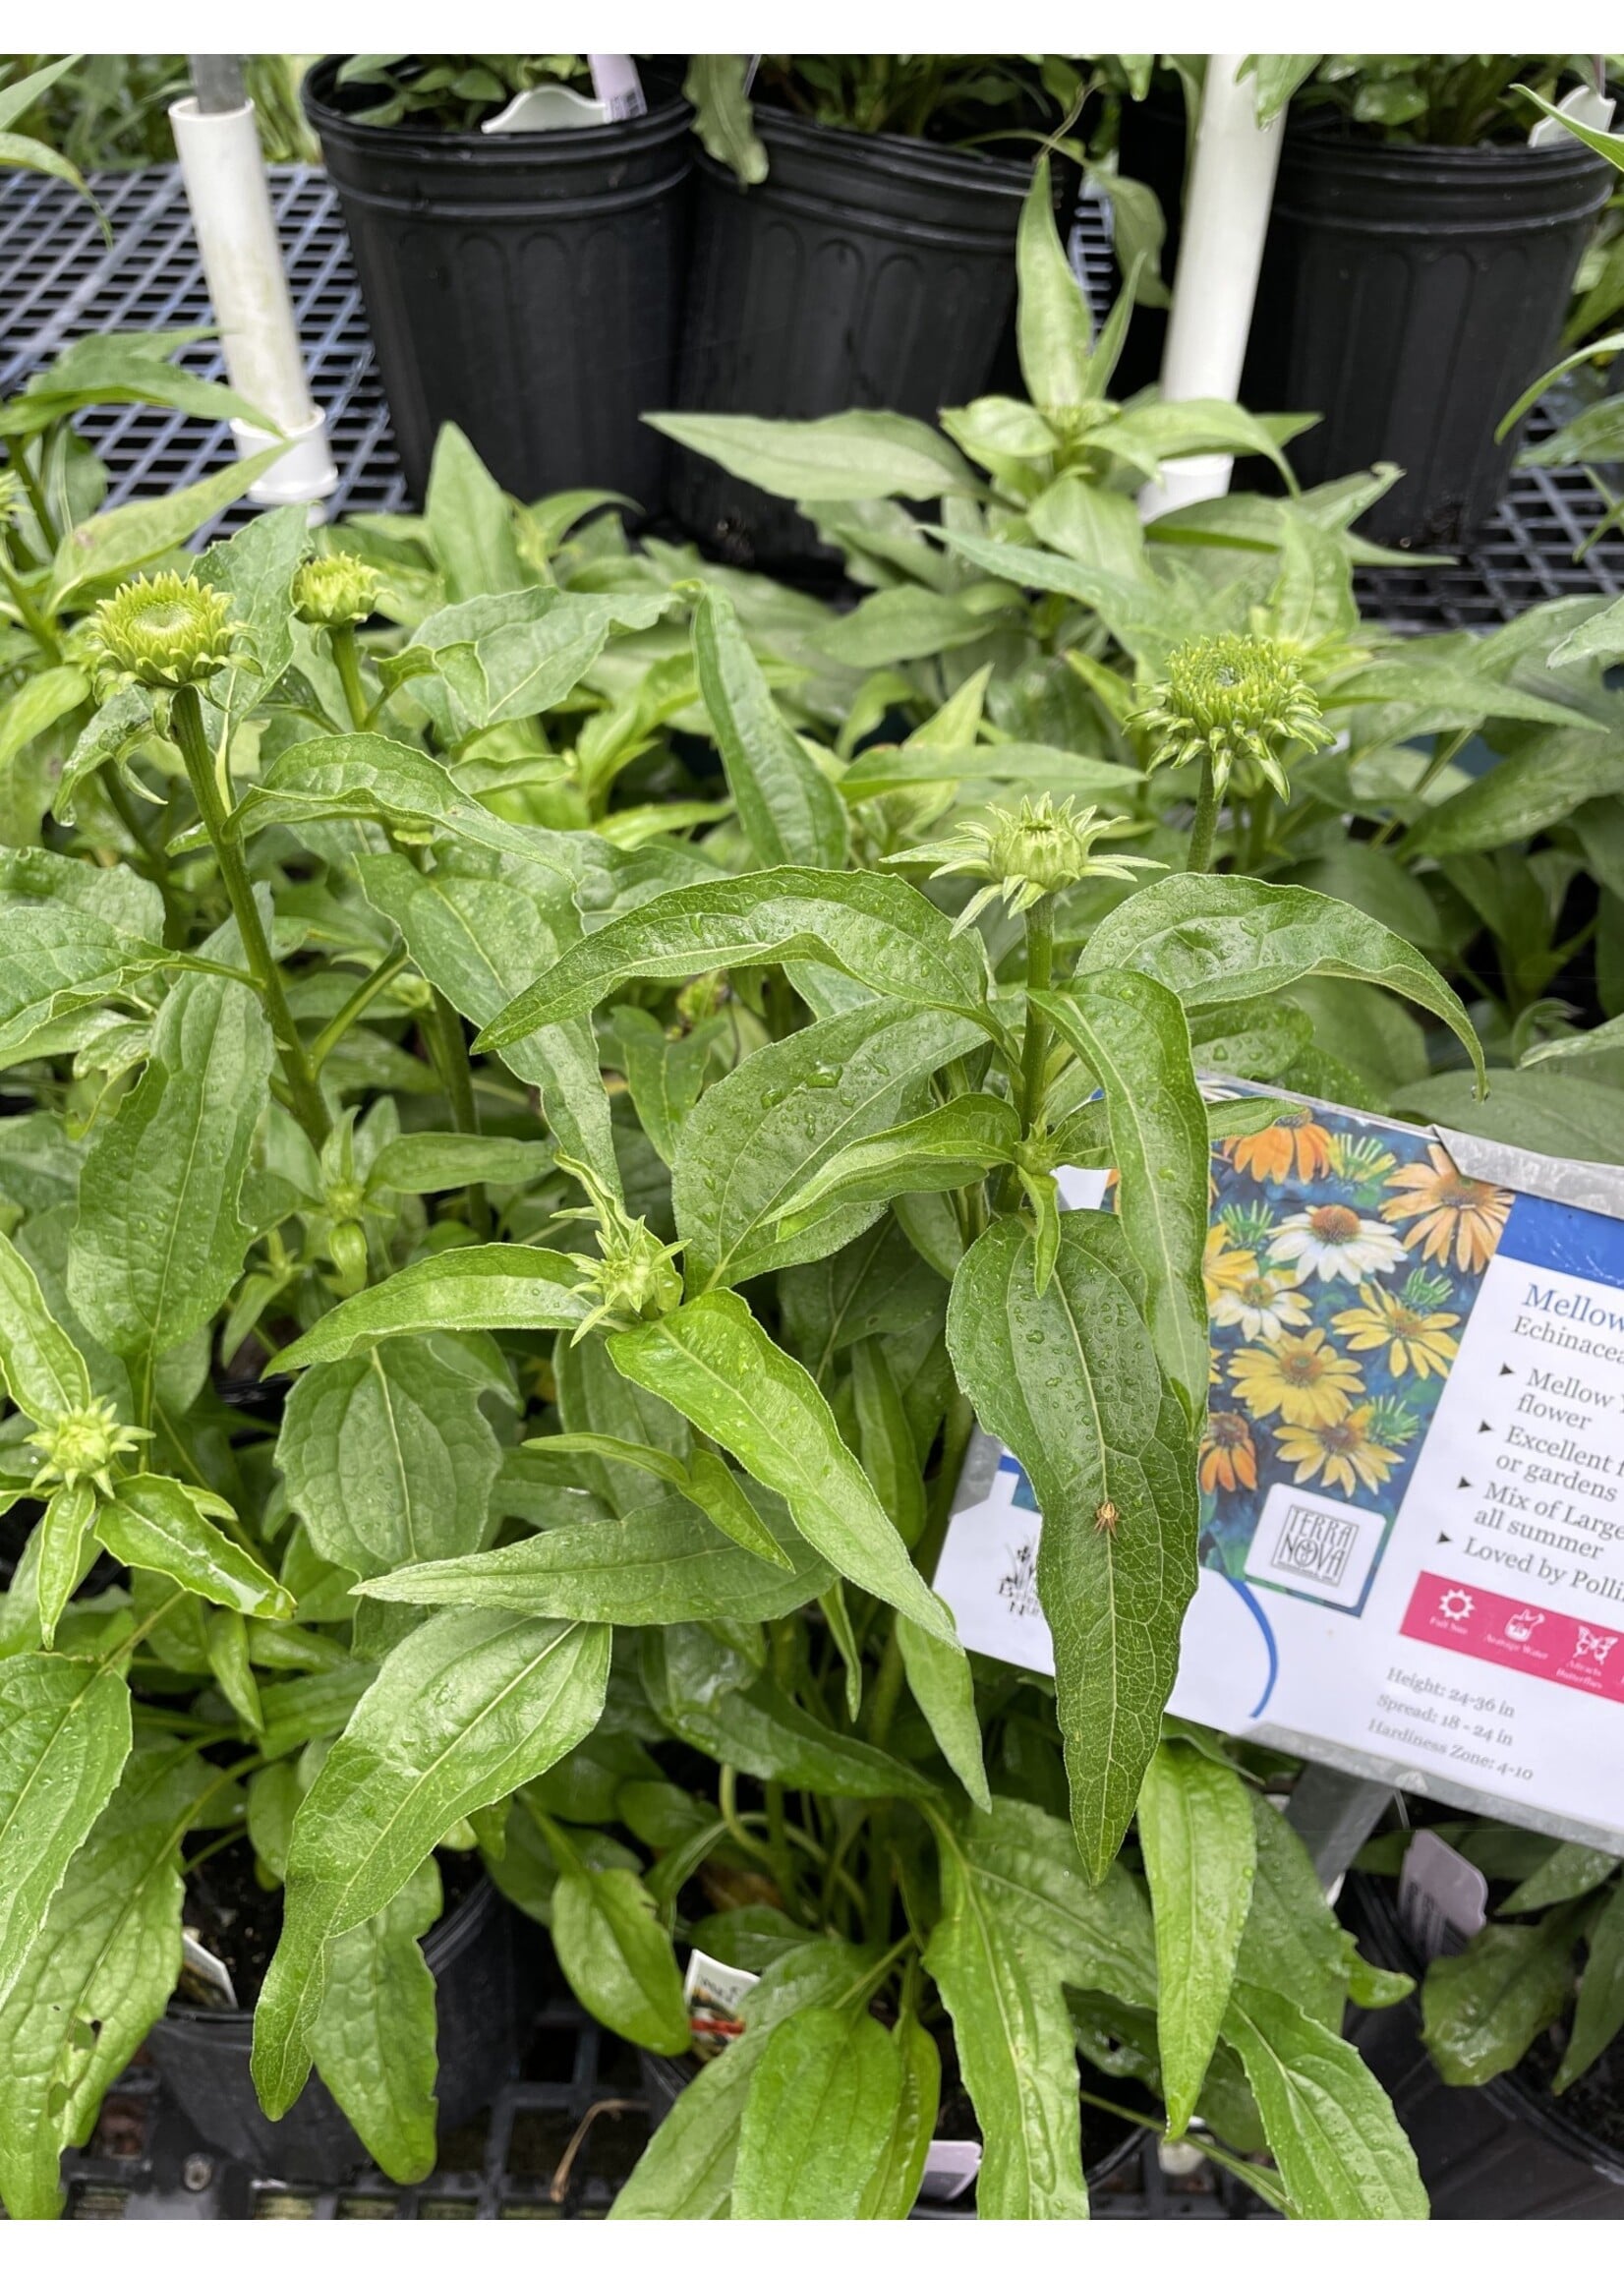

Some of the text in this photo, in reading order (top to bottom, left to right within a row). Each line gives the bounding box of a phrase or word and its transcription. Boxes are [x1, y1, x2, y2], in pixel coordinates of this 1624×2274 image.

[1516, 1392, 1593, 1430] flower
[1526, 1368, 1615, 1408] Mellow
[1505, 1425, 1613, 1474] Excellent
[1483, 1481, 1531, 1511] Mix
[1534, 1499, 1564, 1520] of
[1496, 1454, 1618, 1503] or gardens
[1290, 1507, 1355, 1548] TERRA
[1474, 1507, 1604, 1561] all summer
[1278, 1534, 1346, 1577] NOVA
[1463, 1536, 1624, 1603] Loved by Polli
[1386, 1666, 1516, 1719] Height: 24-36 in
[1376, 1694, 1438, 1723] Spread:
[1440, 1713, 1462, 1731] 18
[1472, 1724, 1493, 1743] 24
[1495, 1726, 1514, 1747] in
[1367, 1717, 1535, 1781] Hardiness Zone: 4-10
